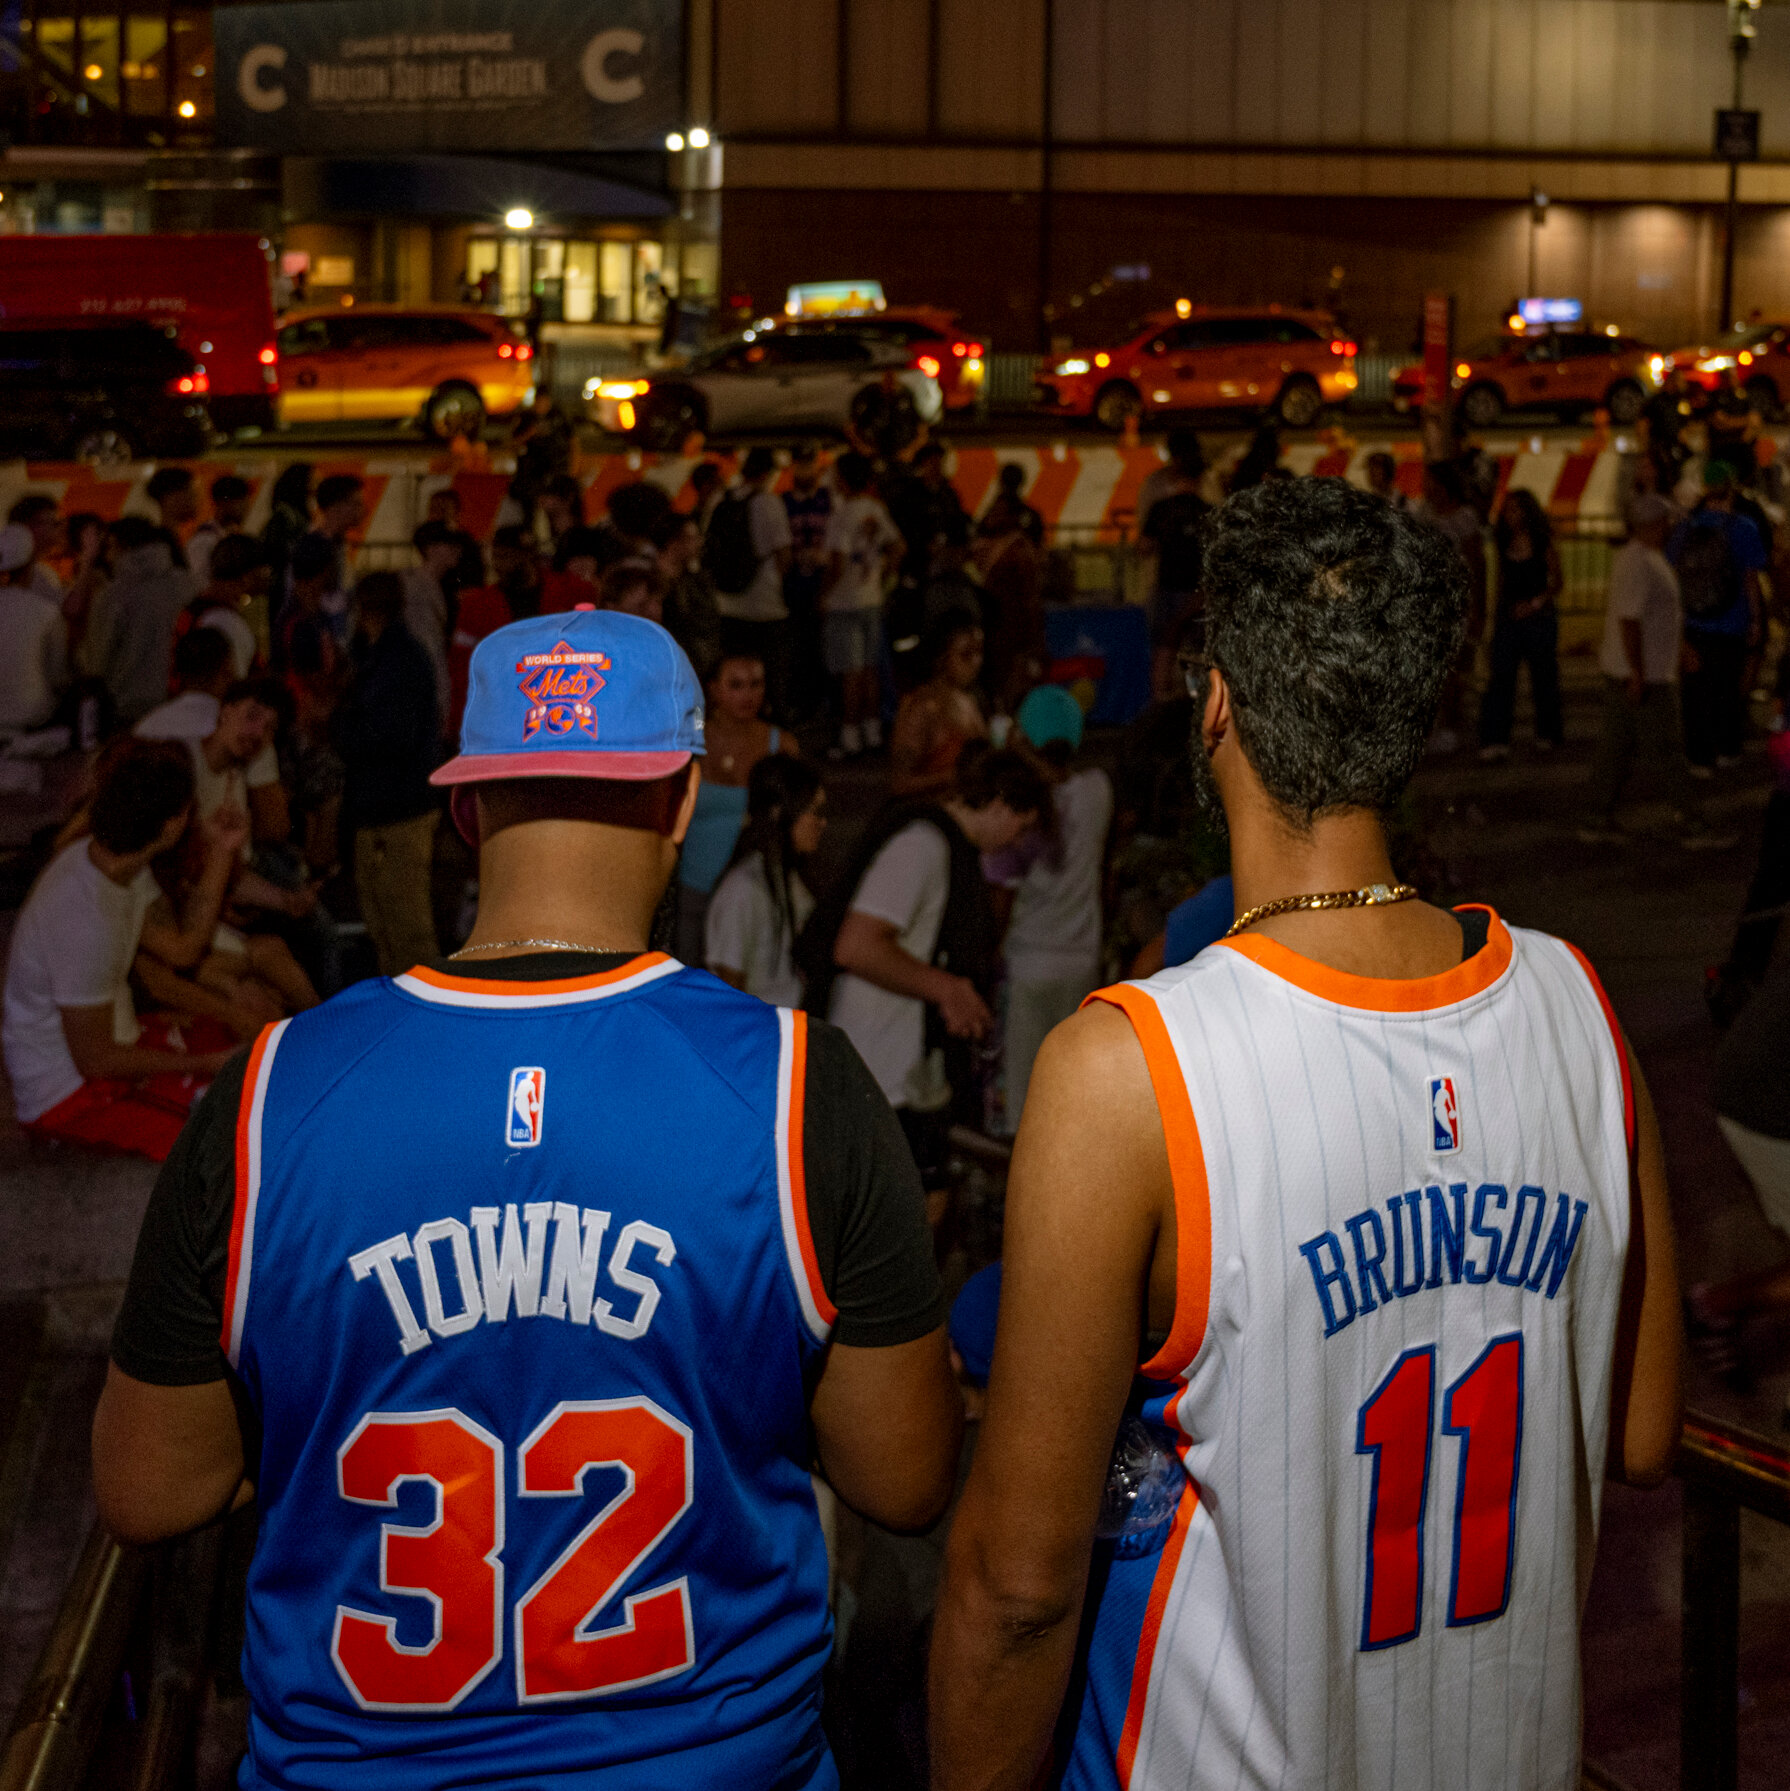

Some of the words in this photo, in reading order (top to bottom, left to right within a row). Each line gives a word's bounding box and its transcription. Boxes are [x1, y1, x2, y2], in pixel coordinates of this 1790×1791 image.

[238, 43, 288, 113] C
[580, 27, 645, 104] C
[525, 654, 562, 665] WORLD
[565, 654, 603, 663] SERIES
[531, 668, 589, 697] Mets
[512, 1128, 530, 1139] NBA
[348, 1201, 676, 1355] TOWNS
[1299, 1182, 1588, 1339] BRUNSON
[1355, 1330, 1523, 1652] 11
[331, 1395, 695, 1713] 32
